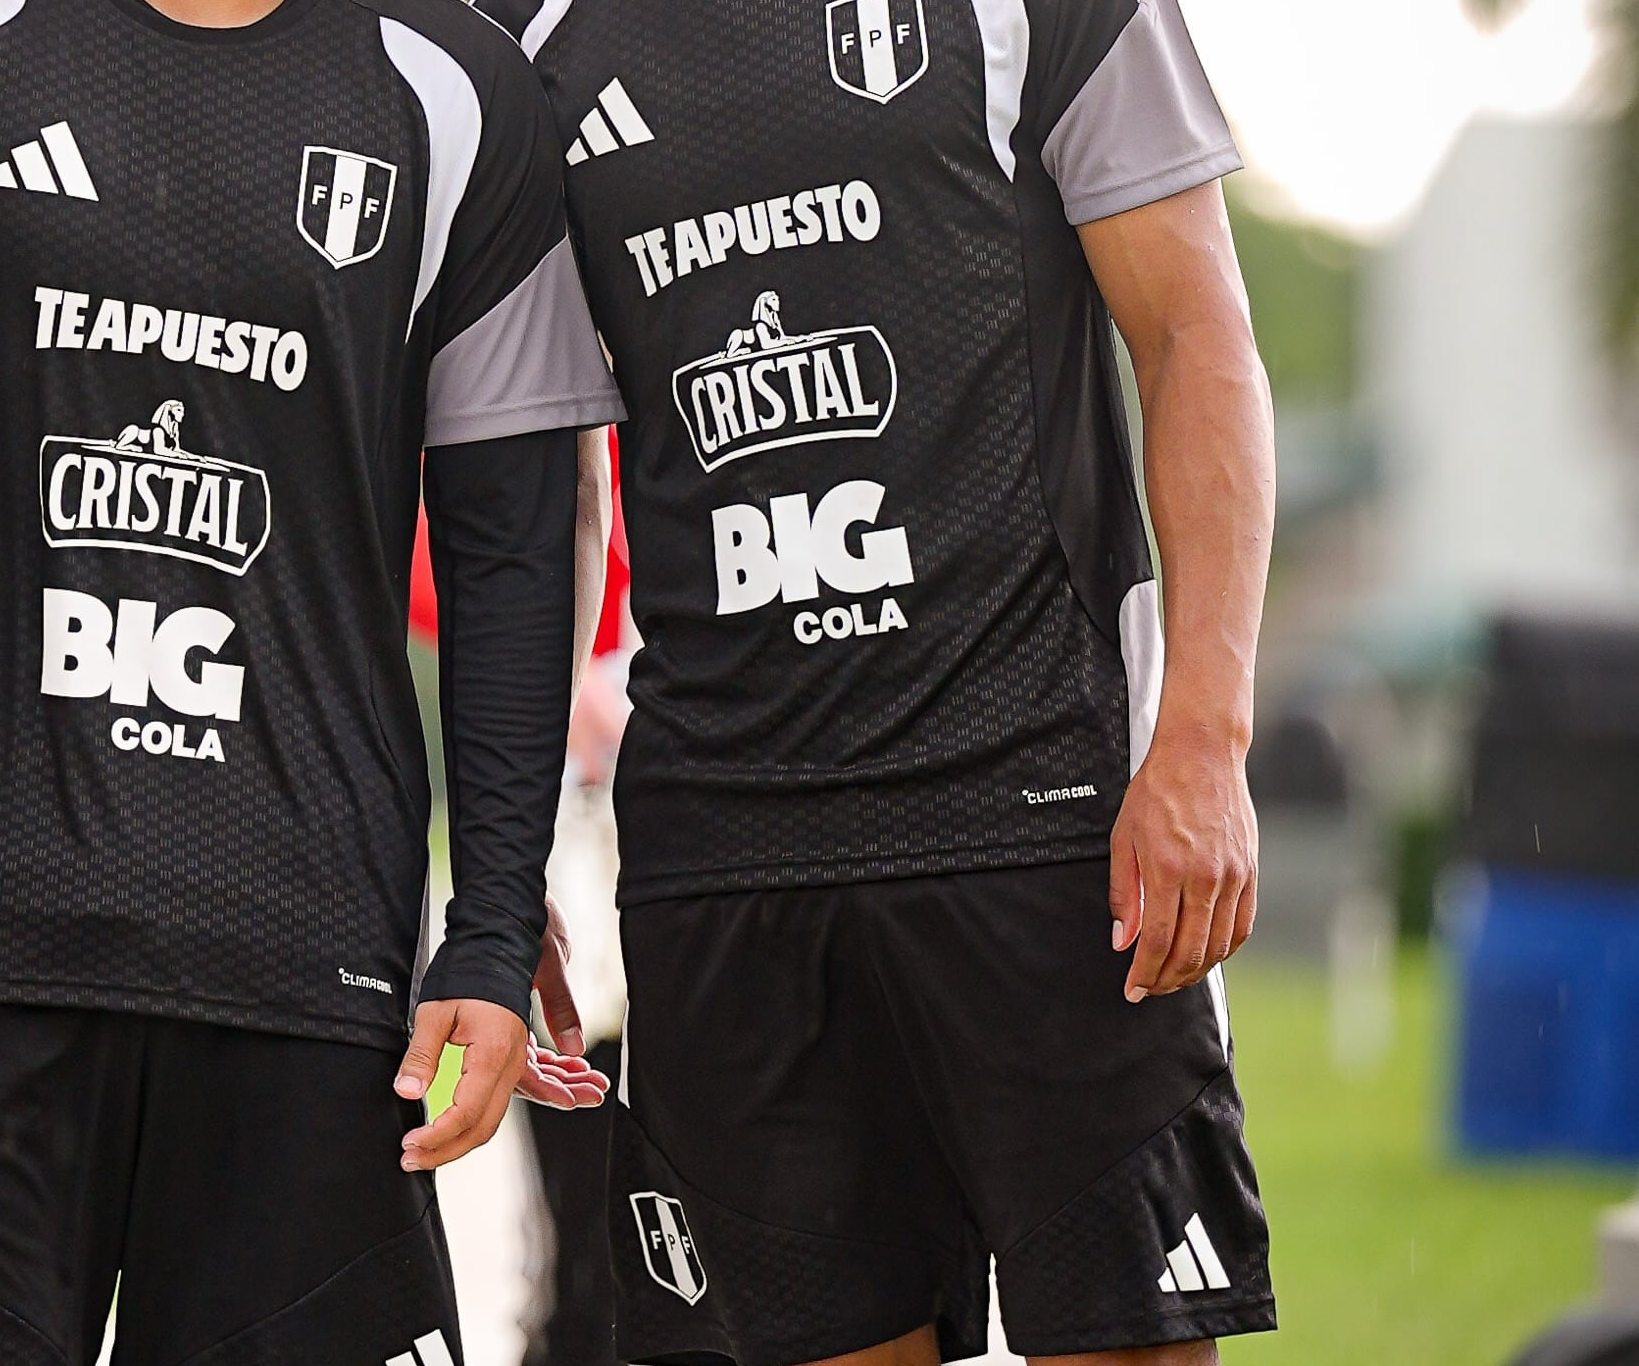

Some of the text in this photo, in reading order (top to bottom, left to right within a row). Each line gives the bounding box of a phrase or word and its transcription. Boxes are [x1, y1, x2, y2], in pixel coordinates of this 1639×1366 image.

[691, 342, 880, 454] CRISTAL
[49, 453, 249, 557] CRISTAL
[711, 480, 916, 616] BIG
[40, 587, 245, 722] BIG
[792, 597, 909, 645] COLA
[110, 717, 227, 763] COLA
